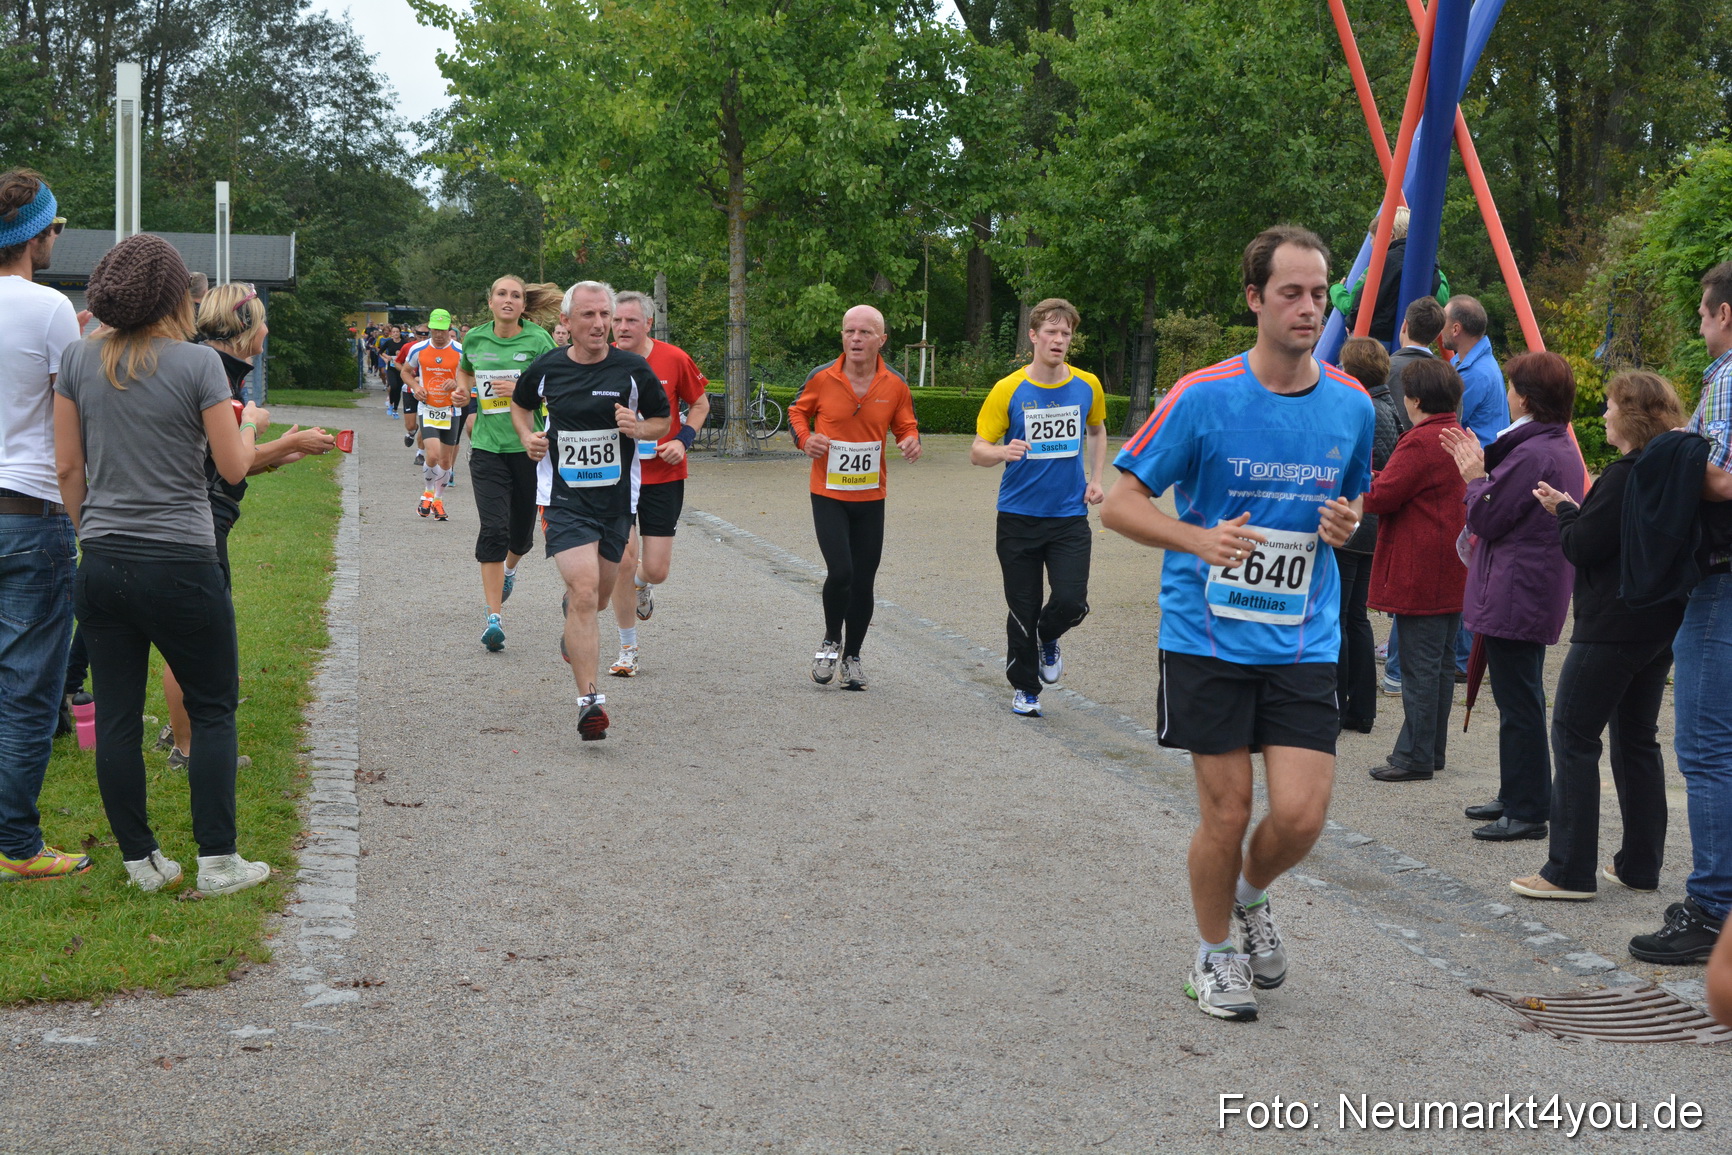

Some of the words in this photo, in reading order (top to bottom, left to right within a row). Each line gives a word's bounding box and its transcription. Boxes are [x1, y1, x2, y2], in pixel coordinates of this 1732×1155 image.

[492, 400, 508, 408] Sina
[428, 410, 447, 420] 629
[1045, 411, 1072, 419] Neumarkt
[1031, 418, 1077, 440] 2526
[579, 435, 609, 443] Neumarkt
[830, 444, 848, 452] PARTL
[1041, 442, 1068, 452] Sascha
[564, 443, 615, 466] 2458
[838, 453, 872, 472] 246
[576, 470, 603, 480] Alfons
[1227, 457, 1340, 486] Tonspur
[841, 475, 867, 484] Roland
[1227, 590, 1287, 611] Matthias
